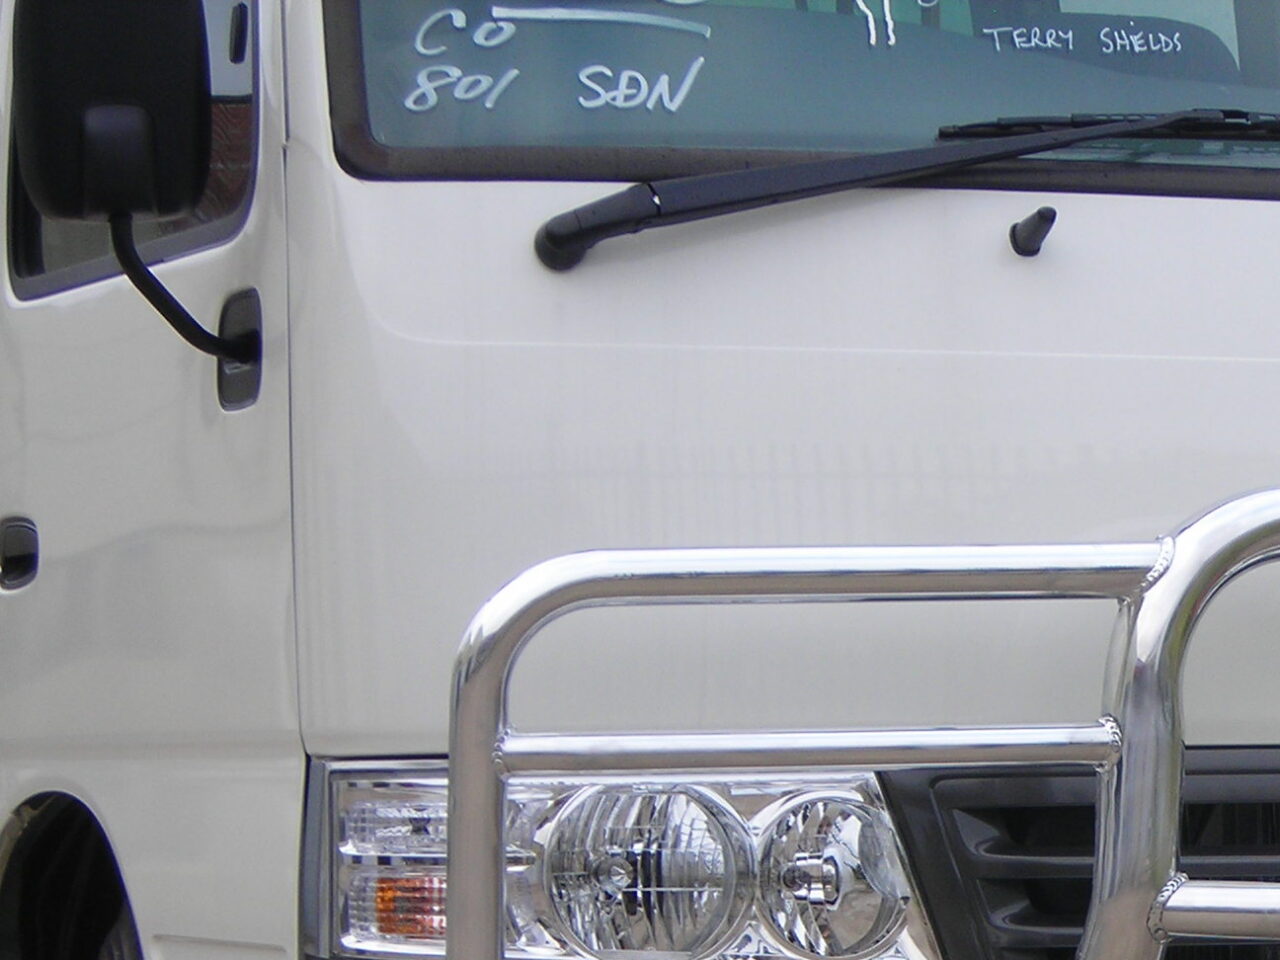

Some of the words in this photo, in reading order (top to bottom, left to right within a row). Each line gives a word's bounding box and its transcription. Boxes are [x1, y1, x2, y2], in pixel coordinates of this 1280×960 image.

[982, 26, 1074, 52] TERRY
[403, 65, 521, 112] 801
[577, 56, 705, 113] SDN
